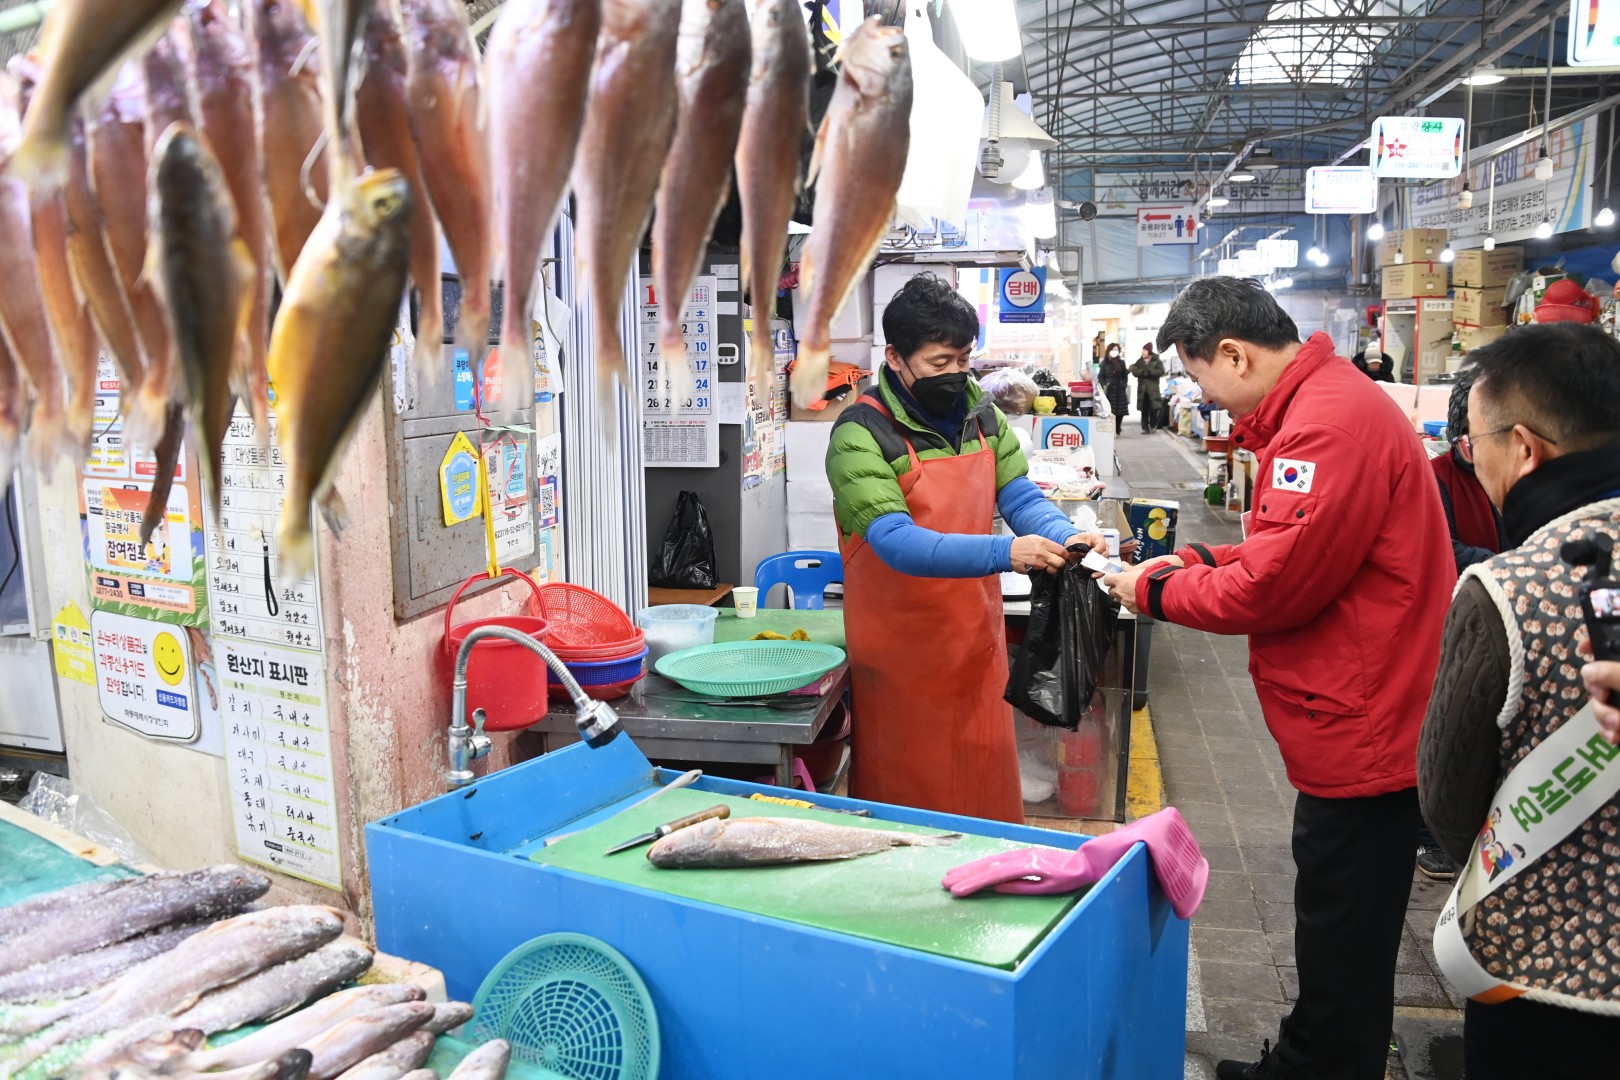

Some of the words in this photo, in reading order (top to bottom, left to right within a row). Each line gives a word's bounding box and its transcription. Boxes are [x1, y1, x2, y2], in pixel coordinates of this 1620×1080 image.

[1520, 190, 1546, 210] 성공한다
[1140, 222, 1175, 232] 공용화장실
[645, 284, 658, 305] 1
[1008, 281, 1038, 296] 담배
[681, 323, 689, 333] 2
[697, 323, 705, 333] 3
[648, 342, 656, 353] 7
[695, 341, 708, 352] 10
[647, 360, 658, 371] 14
[695, 360, 708, 371] 17
[647, 379, 658, 390] 21
[695, 379, 708, 390] 24
[646, 398, 660, 408] 28
[696, 397, 708, 408] 31
[1050, 433, 1081, 447] 담배
[105, 509, 122, 521] 온누리
[105, 522, 130, 535] 환급행사
[107, 541, 148, 561] 참여점포
[282, 588, 305, 603] 중국산
[227, 653, 265, 678] 원산지
[269, 661, 308, 687] 표시판
[286, 805, 316, 825] 러시아
[286, 826, 317, 848] 중국산
